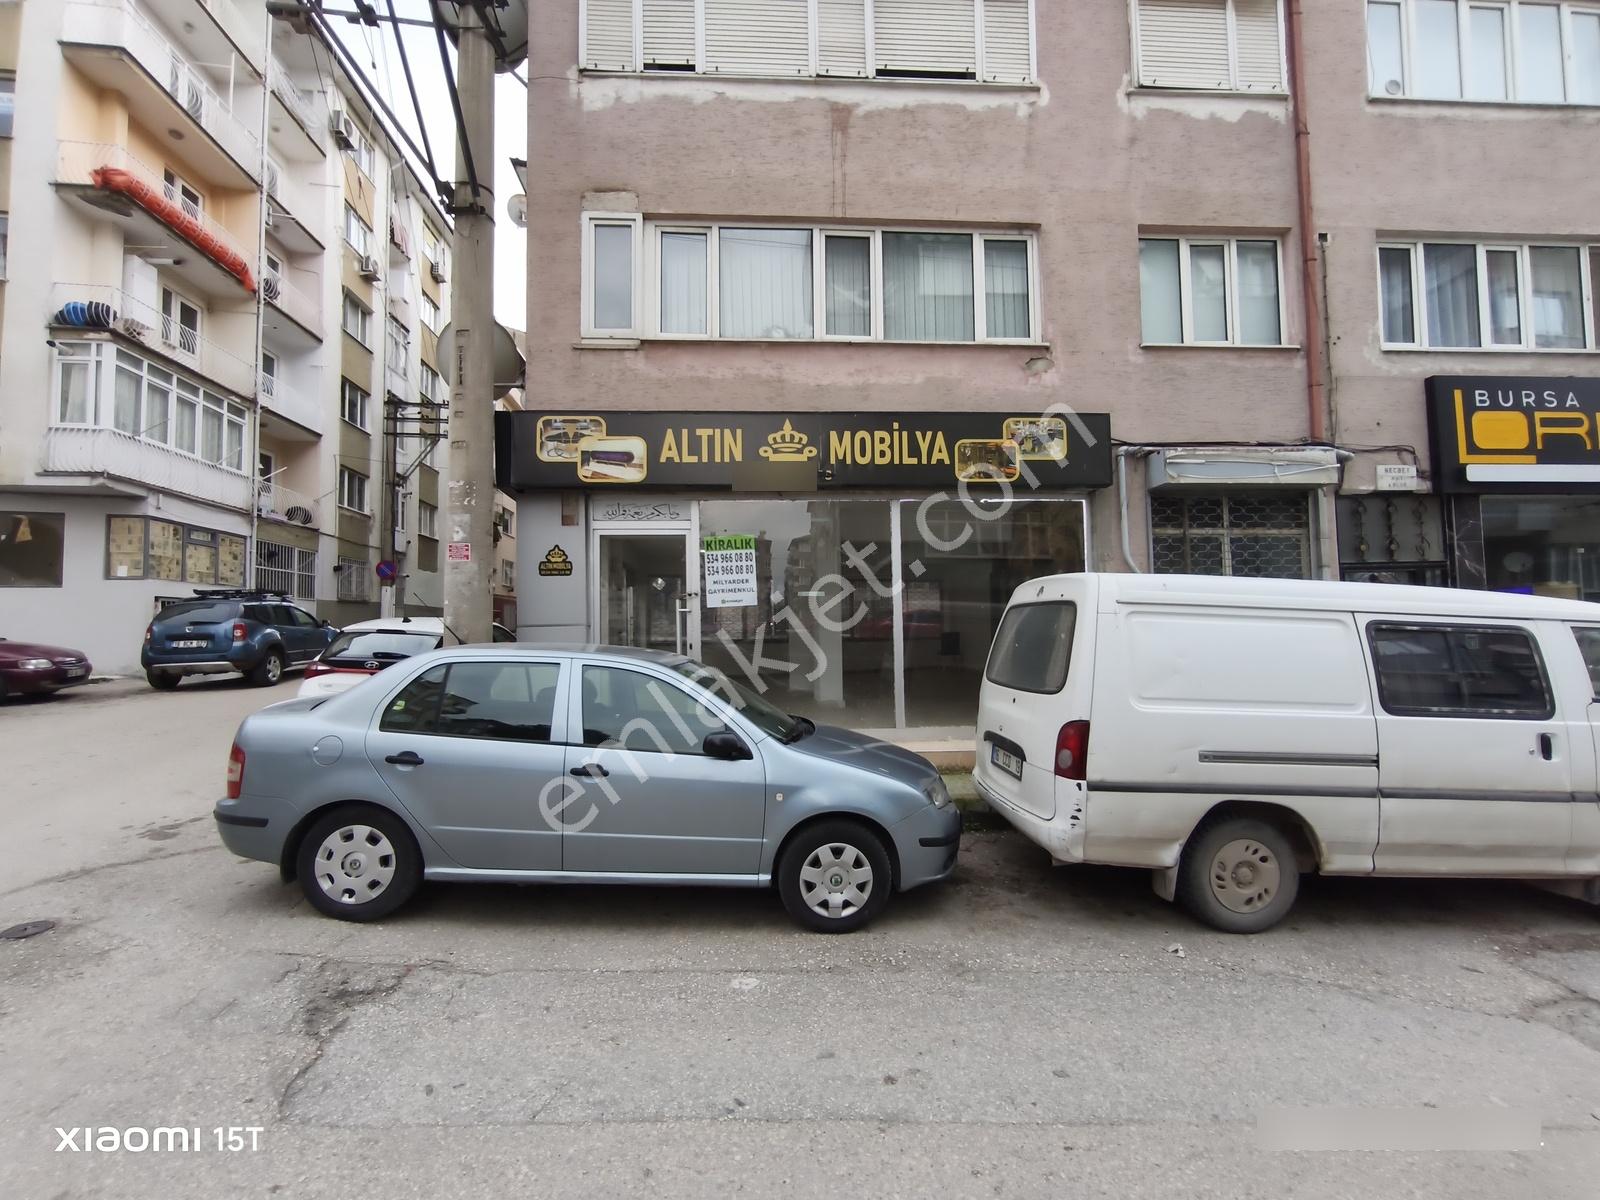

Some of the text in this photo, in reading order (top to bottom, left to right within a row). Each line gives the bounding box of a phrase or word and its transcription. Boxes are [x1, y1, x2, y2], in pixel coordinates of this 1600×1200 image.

[1474, 389, 1580, 408] BURSA
[1453, 388, 1600, 464] LOR
[659, 421, 951, 466] ALTIN MOBİLYA
[707, 553, 719, 564] 534
[721, 552, 733, 563] 966
[735, 552, 744, 562] 08
[707, 565, 719, 576] 534
[721, 565, 734, 576] 966
[735, 564, 744, 575] 08
